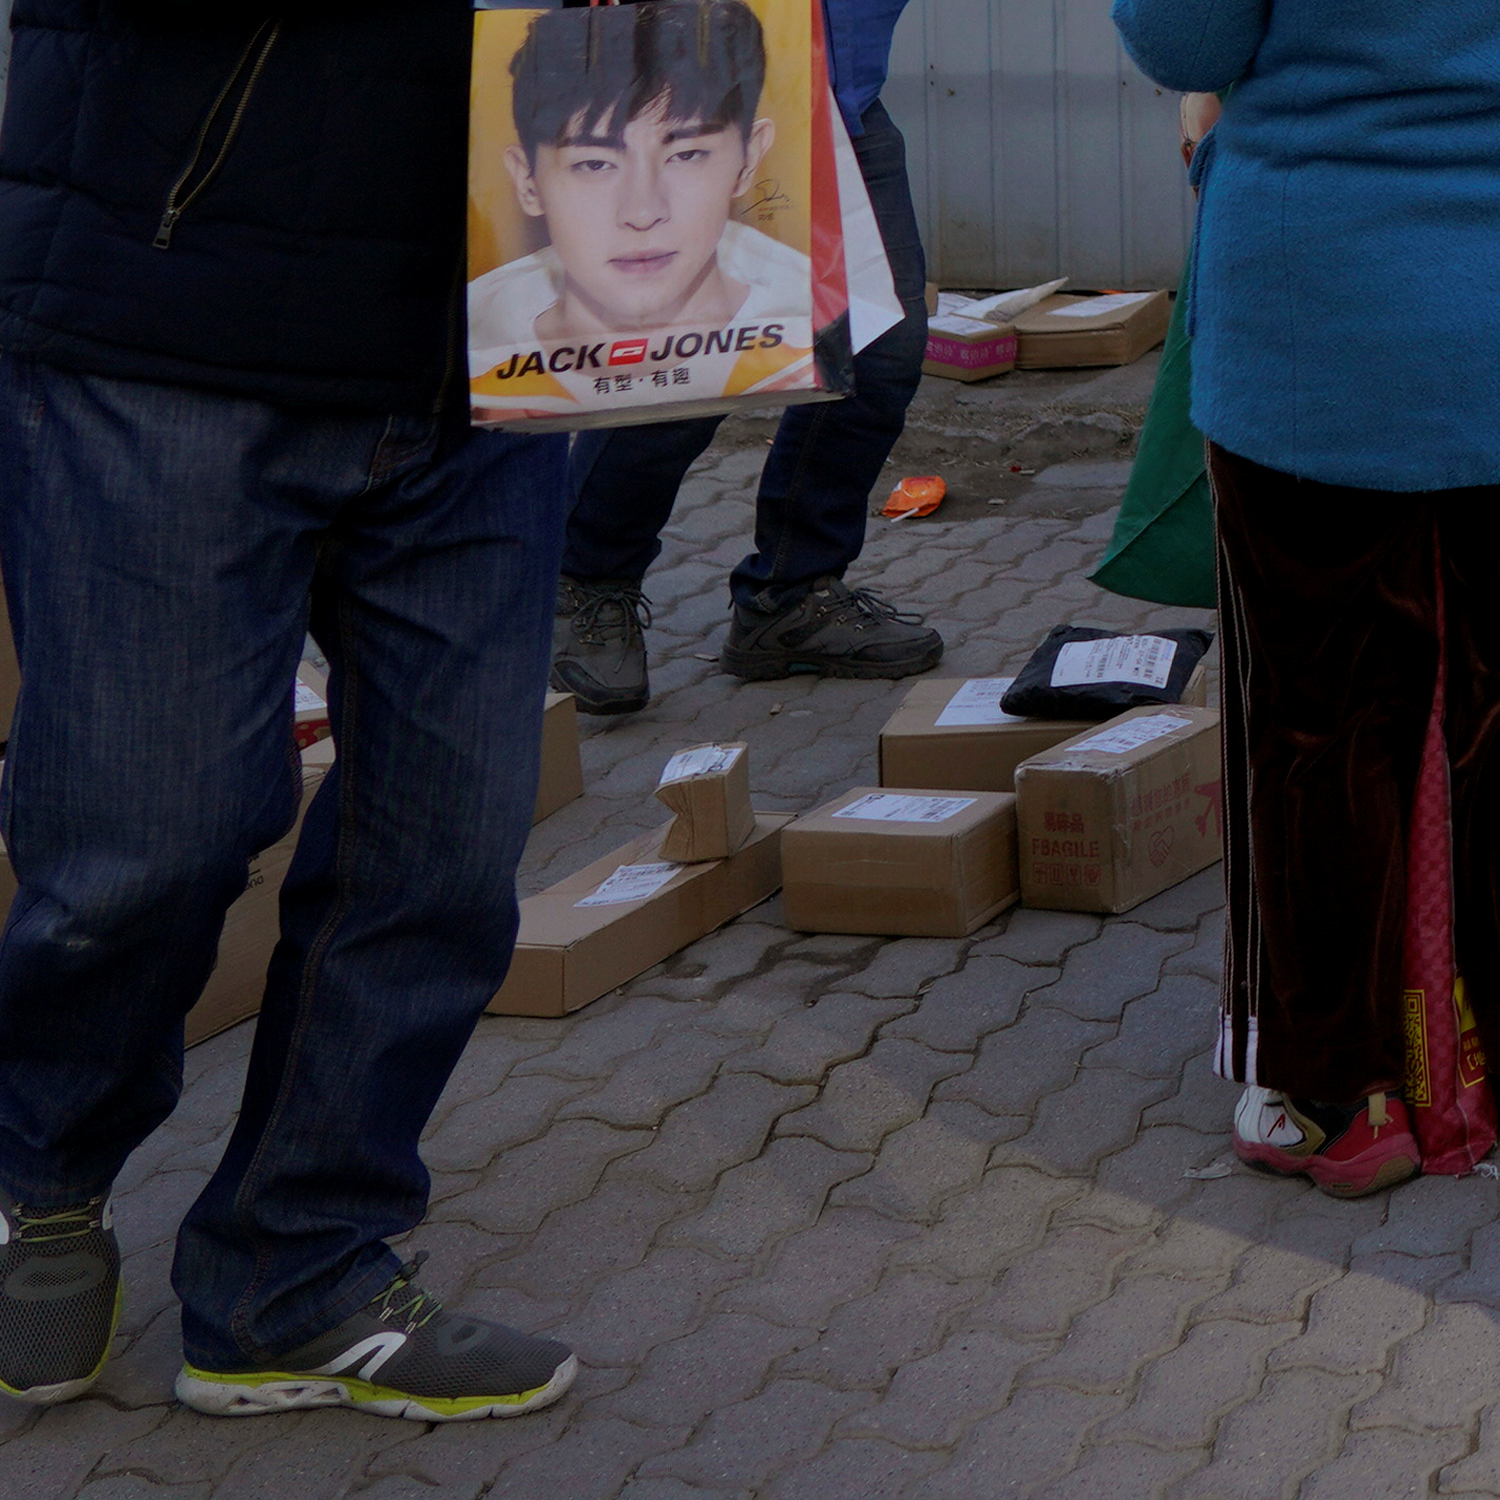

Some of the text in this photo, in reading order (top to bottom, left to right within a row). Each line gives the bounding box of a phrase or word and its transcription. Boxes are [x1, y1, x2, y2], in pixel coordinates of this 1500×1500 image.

[497, 323, 785, 380] JACK JONES
[1044, 811, 1085, 834] 易碎品
